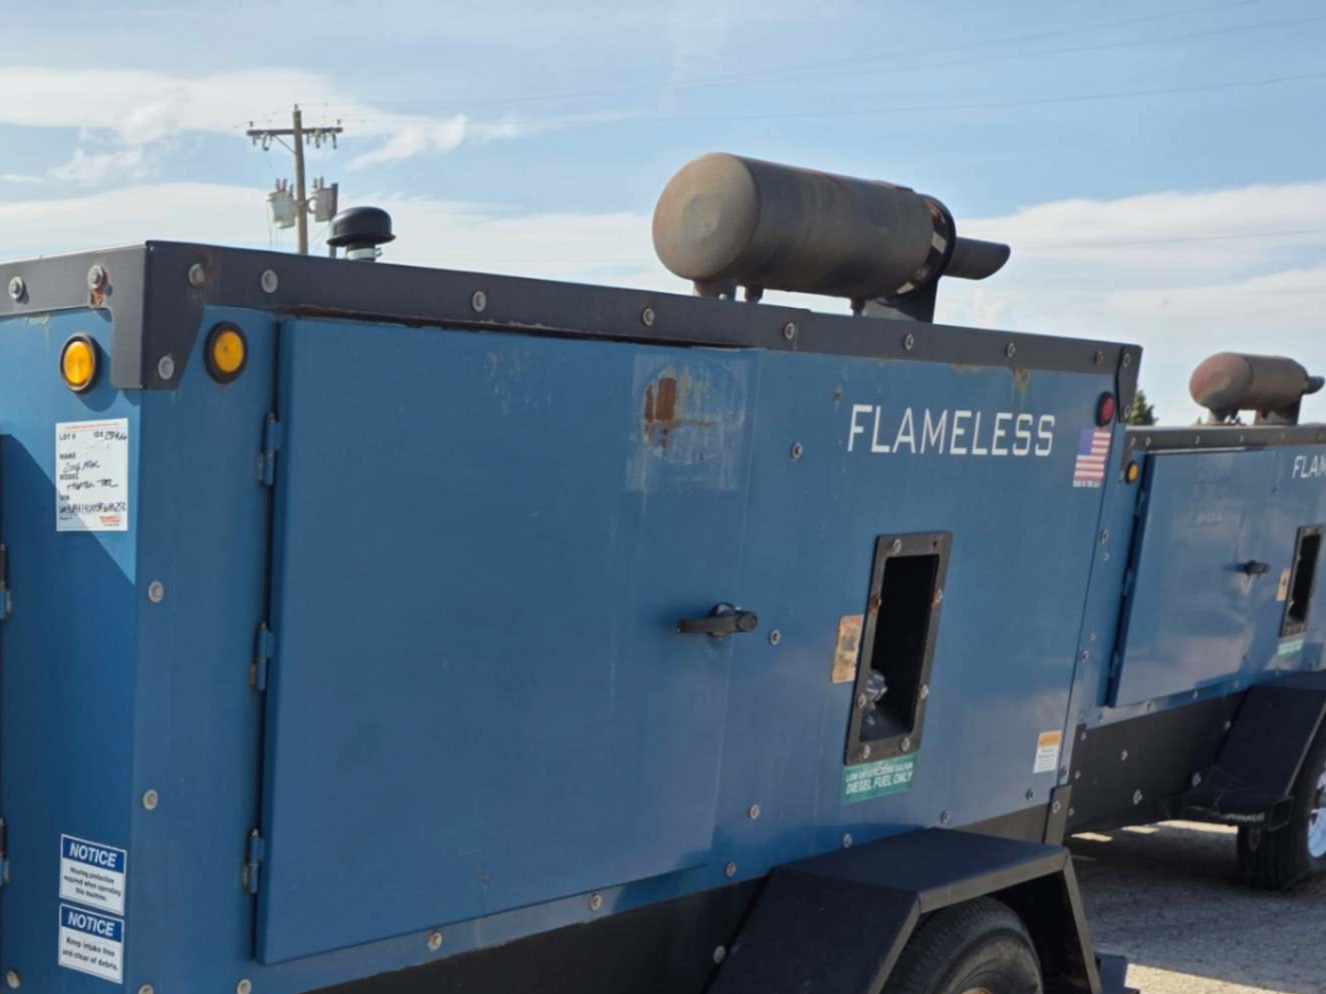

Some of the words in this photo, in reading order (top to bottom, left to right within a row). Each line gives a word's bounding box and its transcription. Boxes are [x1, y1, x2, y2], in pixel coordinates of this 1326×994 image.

[847, 404, 1056, 457] FLAMELESS
[846, 778, 872, 794] DIESEL
[873, 774, 892, 789] FUEL
[69, 843, 117, 868] NOTICE
[68, 911, 115, 937] NOTICE
[66, 936, 81, 948] Keep
[82, 941, 101, 953] intake
[102, 947, 115, 957] free
[62, 948, 73, 957] and
[74, 951, 89, 962] clear
[90, 955, 97, 964] of
[98, 958, 118, 970] debris.
